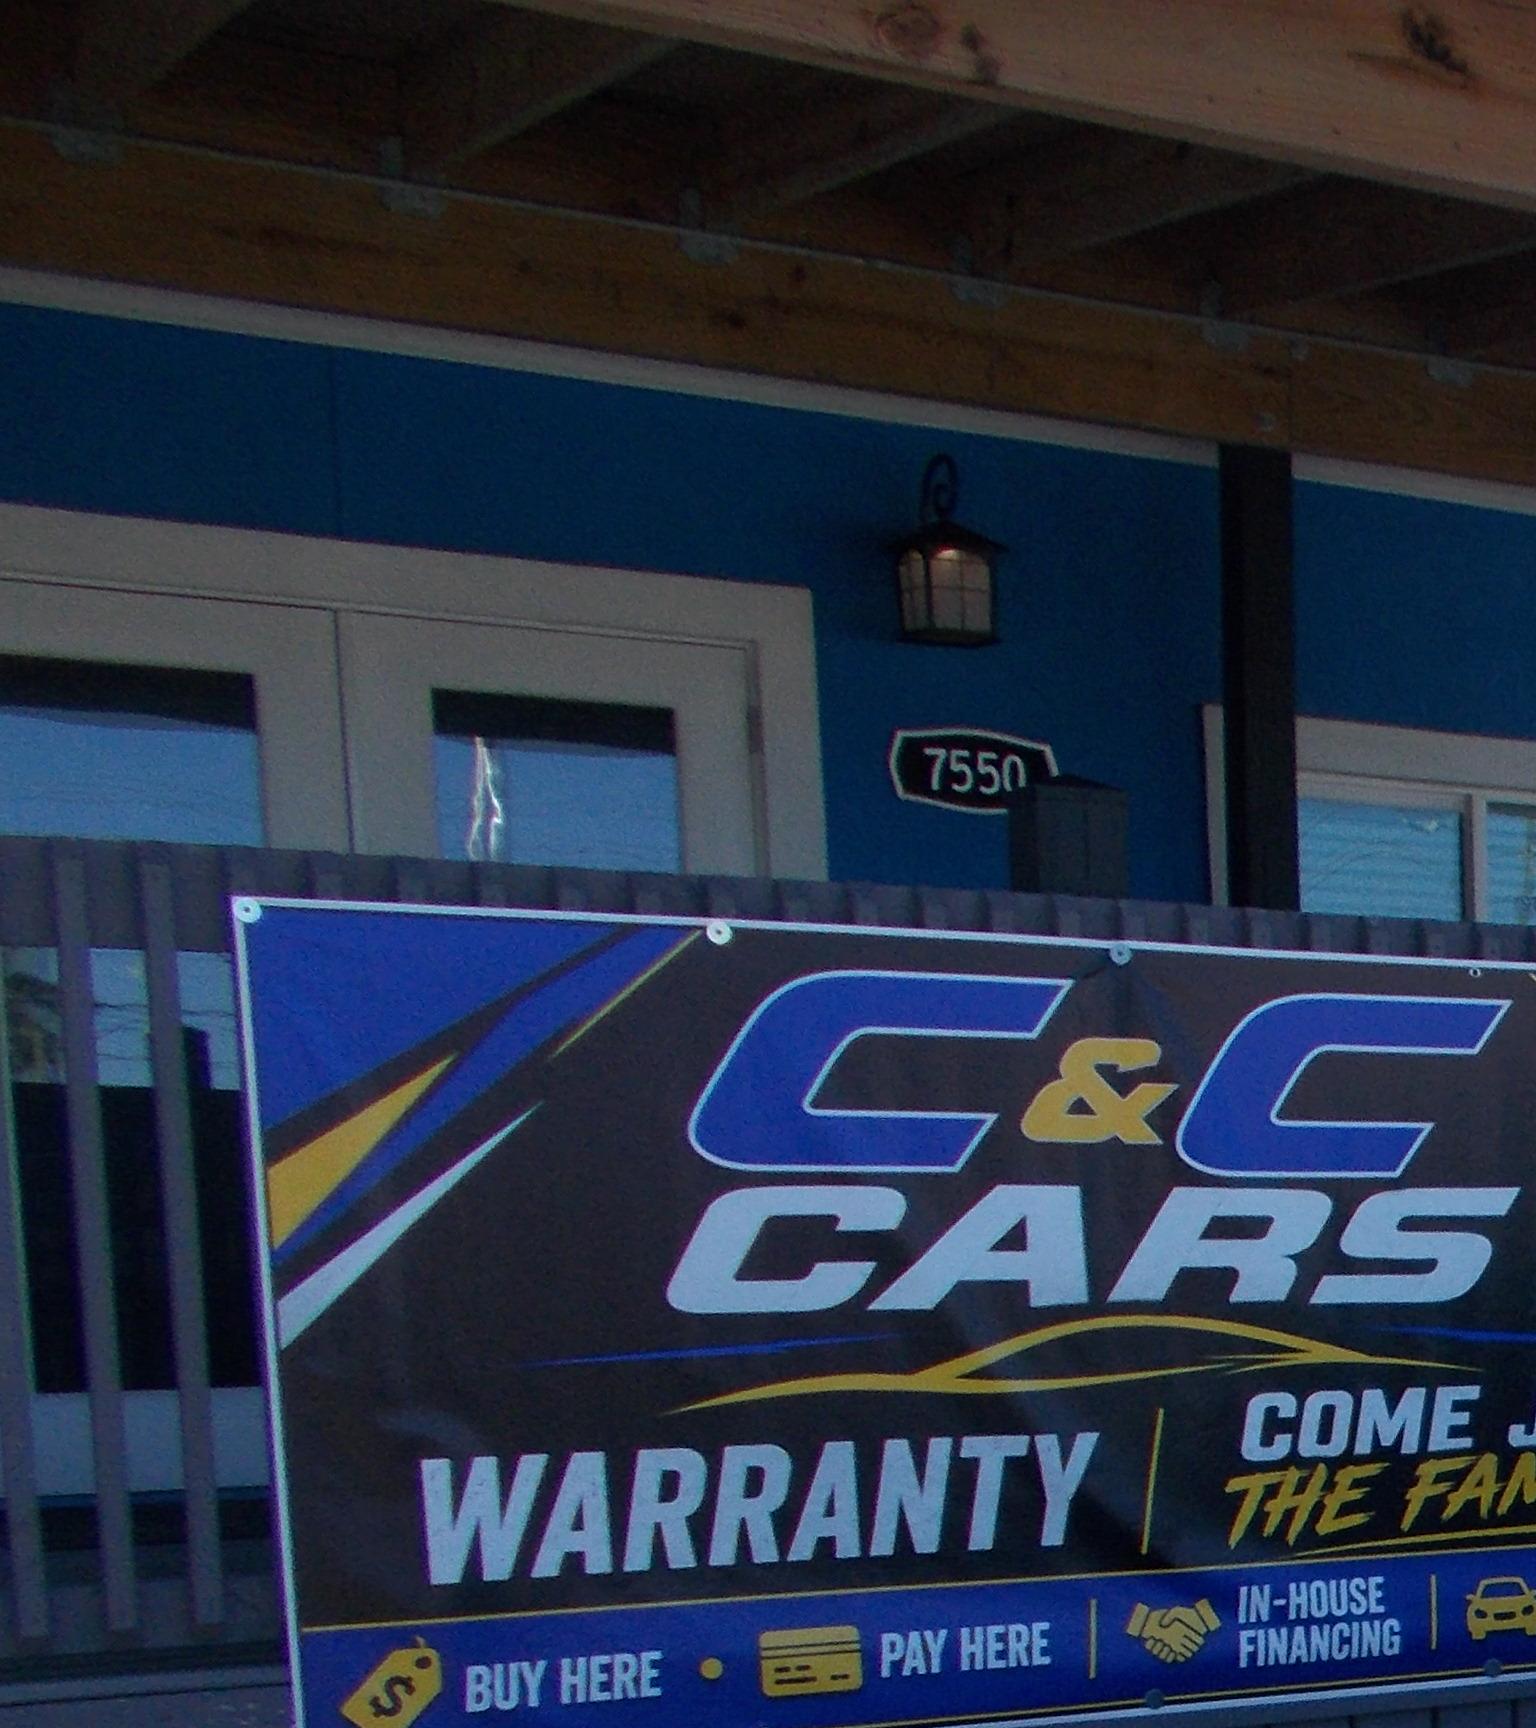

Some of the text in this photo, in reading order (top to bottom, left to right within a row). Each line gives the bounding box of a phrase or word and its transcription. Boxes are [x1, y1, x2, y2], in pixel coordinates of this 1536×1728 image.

[923, 747, 1027, 796] 7550
[666, 1185, 1521, 1314] CARS
[1241, 1385, 1481, 1462] COME
[420, 1432, 1098, 1586] WARRANTY
[1224, 1461, 1391, 1550] THE
[1238, 1576, 1385, 1624] IN-HOUSE
[880, 1622, 1051, 1678] PAY HERE
[1239, 1618, 1401, 1668] FINANCING
[465, 1650, 663, 1713] BUY HERE
